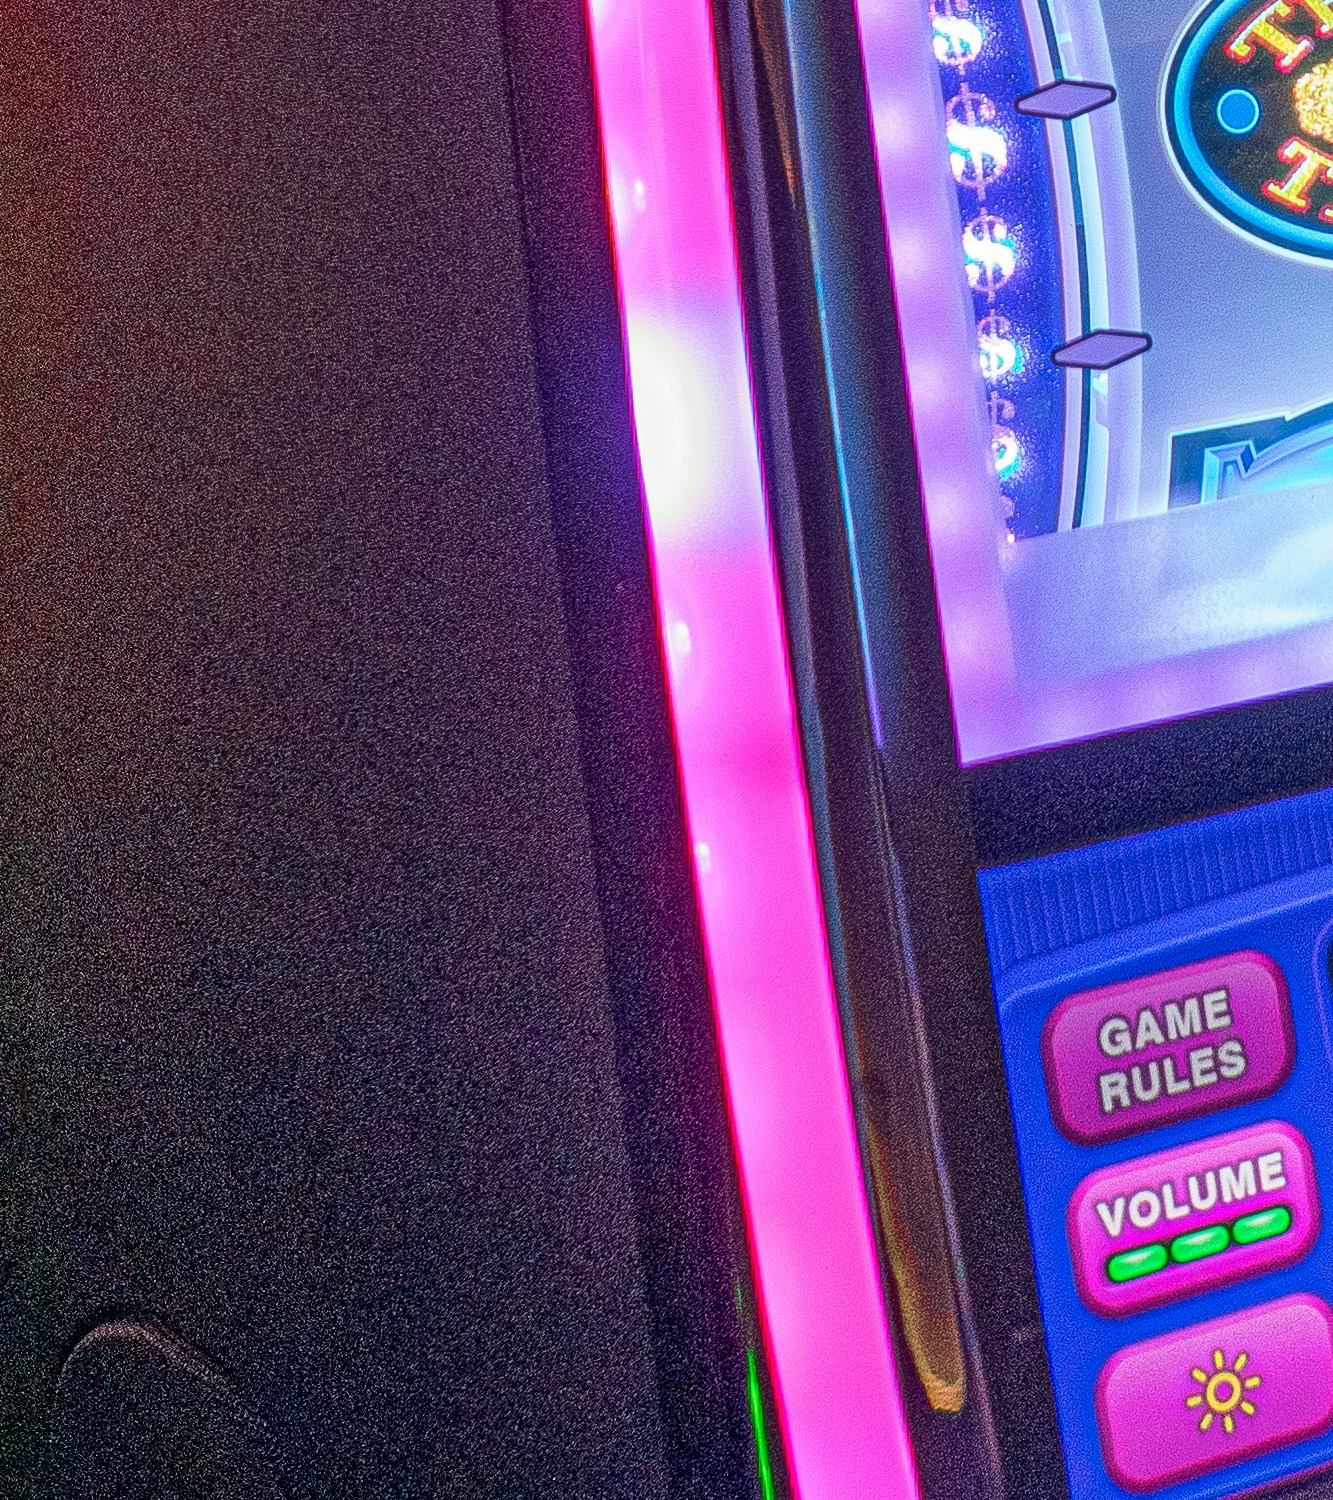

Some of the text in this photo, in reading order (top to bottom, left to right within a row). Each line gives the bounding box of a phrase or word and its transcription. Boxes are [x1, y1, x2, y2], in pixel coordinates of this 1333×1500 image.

[1098, 990, 1232, 1057] GAME
[1098, 1042, 1247, 1114] RULES
[1096, 1151, 1288, 1237] VOLUME
